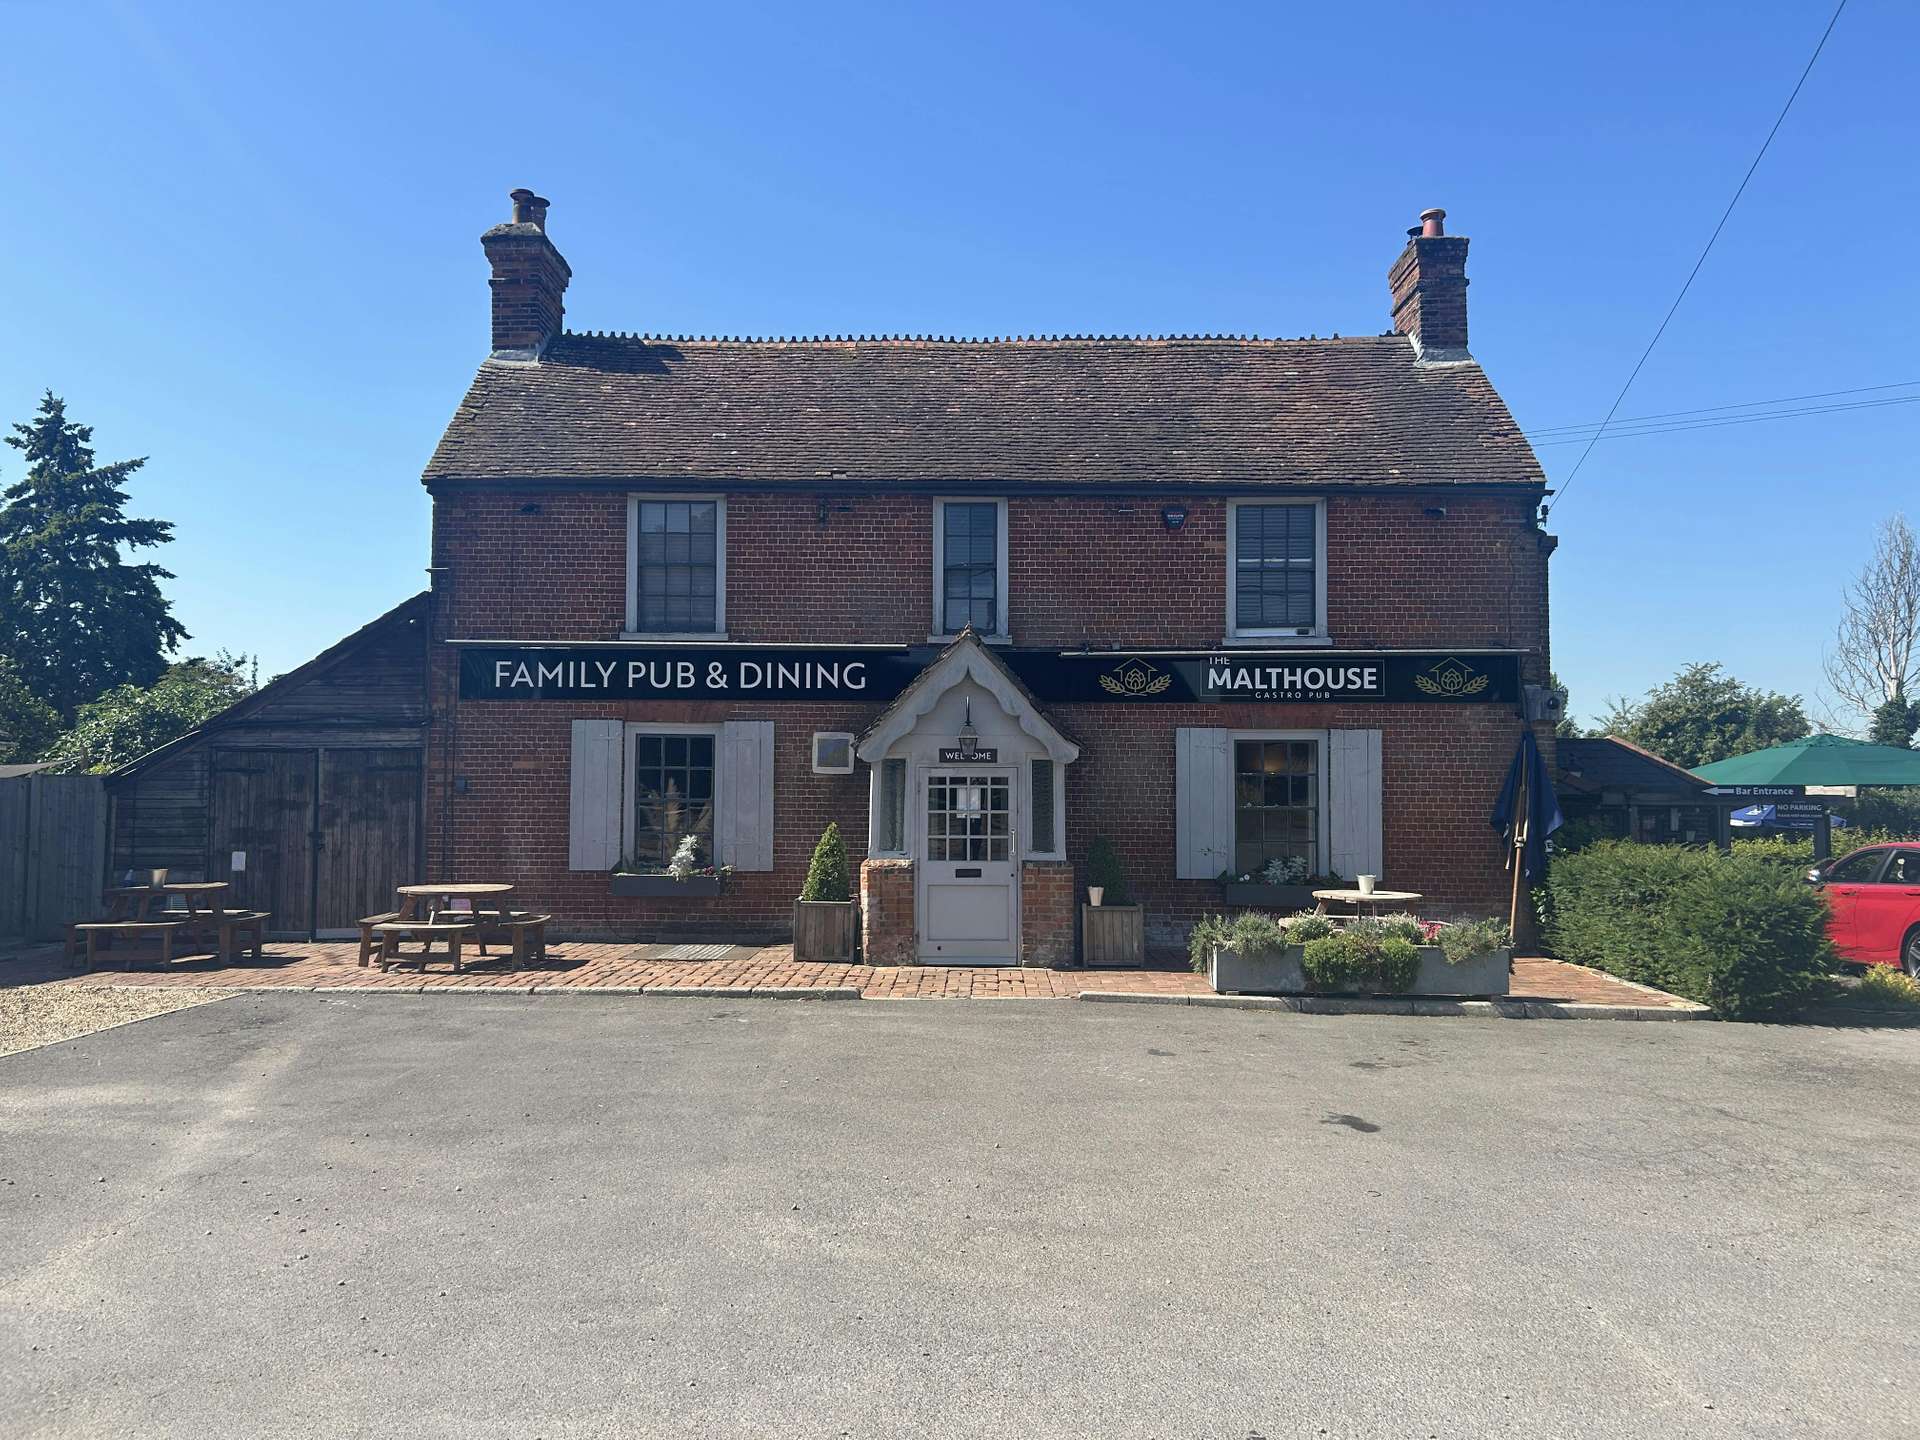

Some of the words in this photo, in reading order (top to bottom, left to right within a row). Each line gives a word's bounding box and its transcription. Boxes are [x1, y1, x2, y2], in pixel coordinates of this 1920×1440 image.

[495, 661, 616, 688] FAMILY
[628, 662, 695, 688] PUB
[705, 662, 728, 688] &
[740, 662, 866, 689] DINING
[1207, 667, 1377, 689] MALTHOUSE
[1255, 691, 1302, 699] GASTRO
[1308, 691, 1330, 699] PUB
[945, 751, 991, 760] WELOME
[1735, 787, 1751, 795] Bar
[1753, 787, 1794, 795] Entrance
